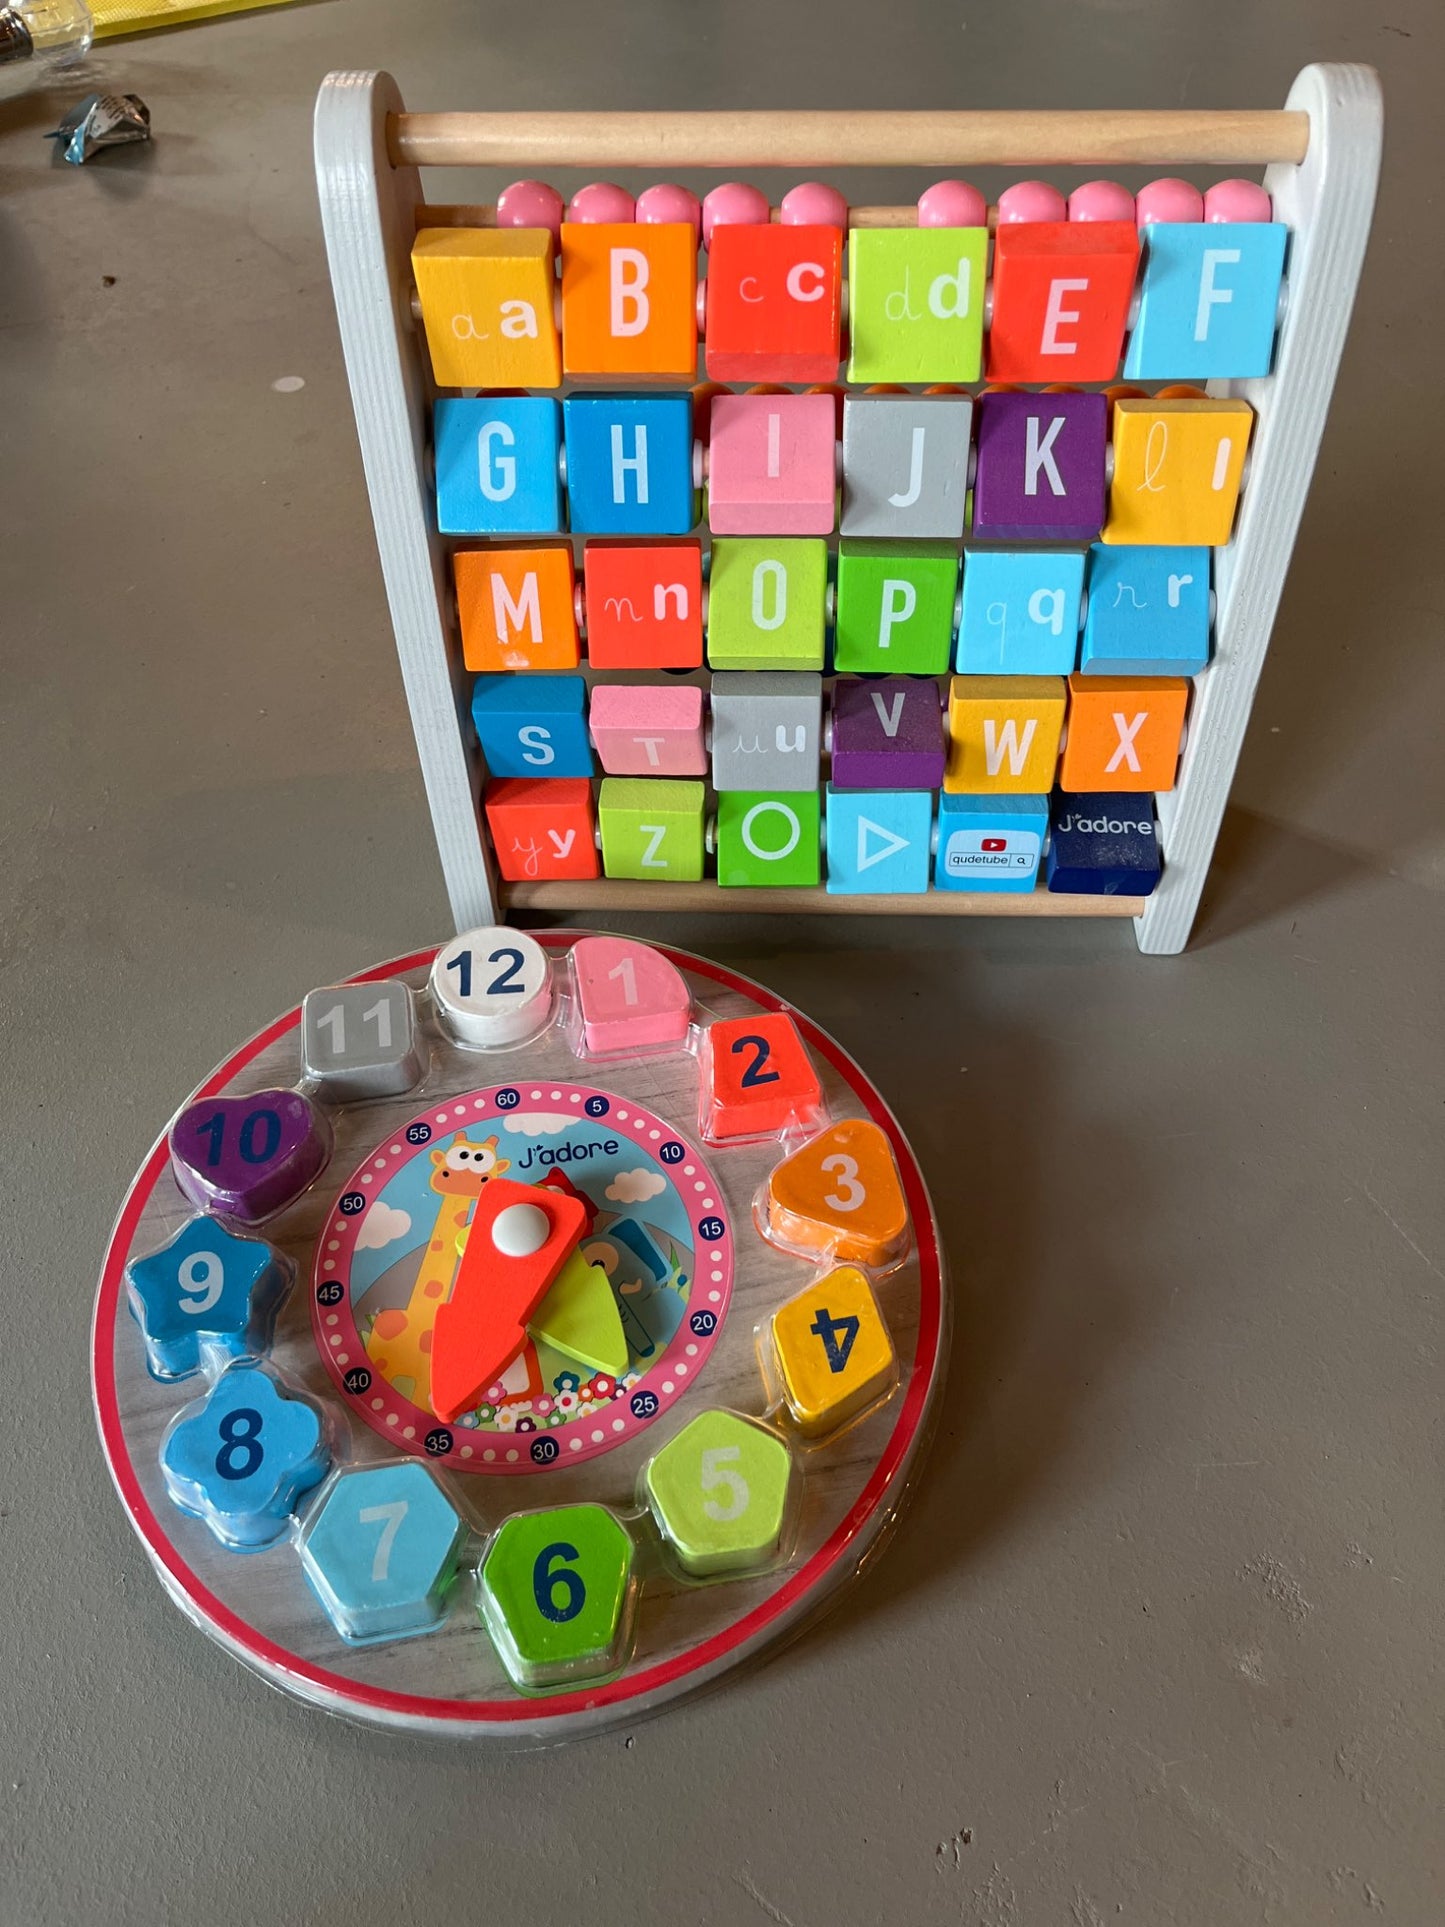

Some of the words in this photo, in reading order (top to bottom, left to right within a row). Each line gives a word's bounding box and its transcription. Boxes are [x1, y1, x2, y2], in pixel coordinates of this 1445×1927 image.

[610, 248, 649, 337] B
[739, 277, 764, 303] c
[786, 262, 825, 302] c
[885, 265, 923, 321] d
[928, 257, 970, 319] d
[1194, 249, 1241, 342] F
[451, 314, 489, 340] a
[500, 301, 538, 339] a
[1040, 278, 1089, 355] E
[478, 421, 516, 501] G
[611, 425, 649, 504] H
[768, 414, 780, 478] I
[888, 427, 925, 508] J
[1024, 417, 1066, 496] K
[491, 572, 543, 645] M
[604, 597, 643, 622] n
[654, 583, 688, 621] n
[1028, 588, 1066, 635] q
[1167, 574, 1193, 608] r
[633, 737, 665, 766] T
[775, 725, 806, 753] u
[547, 829, 576, 859] y
[952, 853, 1009, 866] qudetube
[446, 948, 526, 997] 12
[608, 957, 638, 1006] 1
[316, 999, 393, 1054] 11
[730, 1035, 780, 1088] 2
[497, 1092, 516, 1105] 60
[592, 1100, 602, 1112] 5
[195, 1109, 281, 1166] 10
[409, 1127, 429, 1140] 55
[518, 1139, 619, 1169] J'adore
[663, 1146, 681, 1158] 10
[343, 1196, 363, 1210] 50
[821, 1153, 866, 1211] 3
[701, 1222, 721, 1235] 15
[177, 1251, 225, 1315] 9
[318, 1286, 341, 1300] 45
[692, 1315, 713, 1330] 20
[810, 1308, 860, 1373] 4
[347, 1374, 368, 1388] 40
[633, 1398, 655, 1411] 25
[215, 1408, 264, 1480] 8
[428, 1435, 449, 1451] 35
[533, 1444, 555, 1458] 30
[700, 1446, 750, 1521] 5
[359, 1501, 409, 1582] 7
[532, 1542, 586, 1623] 6
